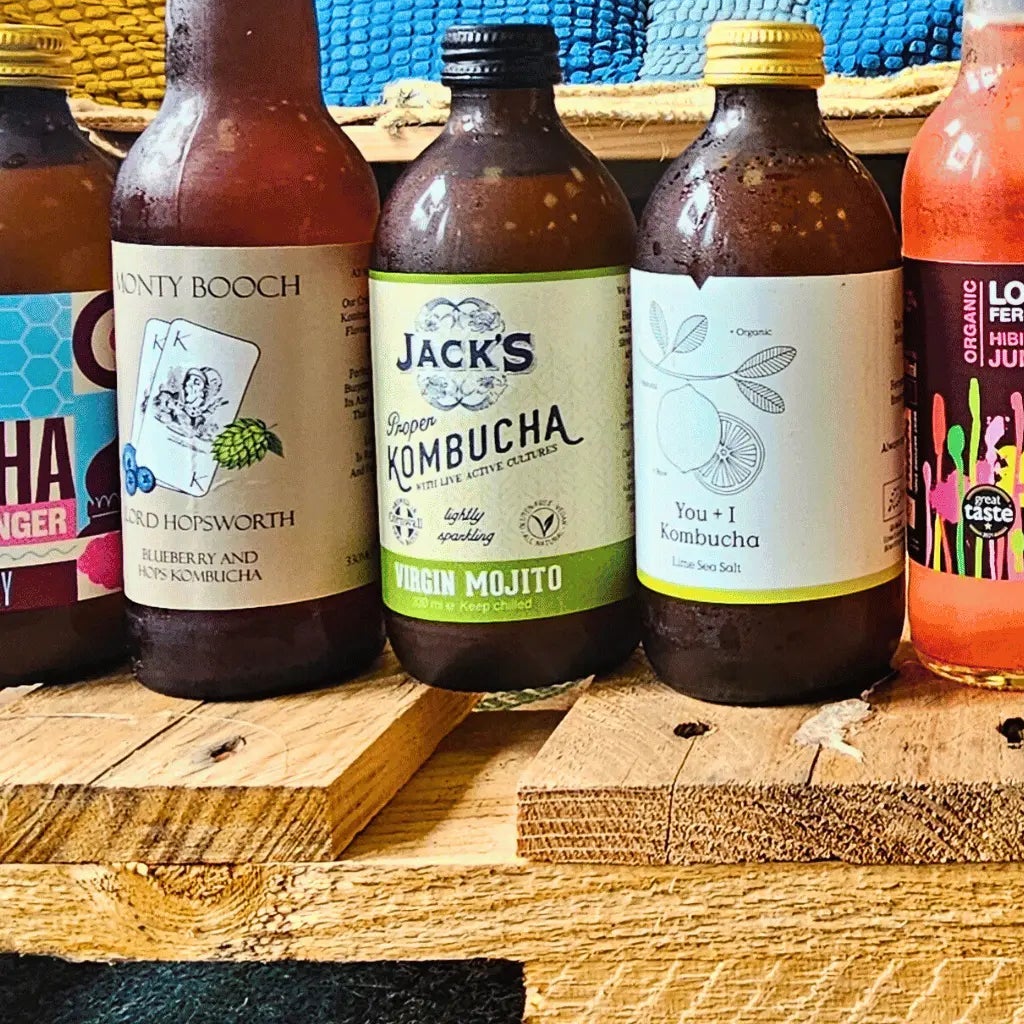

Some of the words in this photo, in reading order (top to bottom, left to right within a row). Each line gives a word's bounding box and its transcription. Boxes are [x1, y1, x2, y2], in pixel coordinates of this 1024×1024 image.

[191, 274, 300, 299] BOOCH
[963, 279, 978, 364] ORGANIC
[736, 328, 773, 338] Organic
[396, 332, 535, 372] JACK'S
[386, 411, 437, 442] Proper
[387, 404, 585, 493] KOMBUCHA
[416, 478, 438, 491] WITH
[440, 474, 463, 487] LIVE
[467, 461, 504, 481] ACTIVE
[506, 443, 558, 468] CULTURES
[974, 495, 1002, 507] great
[164, 510, 295, 532] HOPSWORTH
[443, 507, 486, 526] lightly
[675, 501, 708, 523] You
[713, 509, 722, 519] +
[728, 506, 736, 524] I
[964, 503, 1015, 523] taste
[437, 530, 496, 547] sparkling
[660, 522, 760, 549] Kombucha
[142, 547, 217, 566] BLUEBERRY
[220, 550, 259, 564] AND
[697, 559, 718, 572] Sea
[719, 561, 742, 574] Salt
[138, 564, 168, 581] HOPS
[171, 568, 263, 583] KOMBUCHA
[394, 561, 457, 597] VIRGIN
[465, 564, 563, 598] MOJITO
